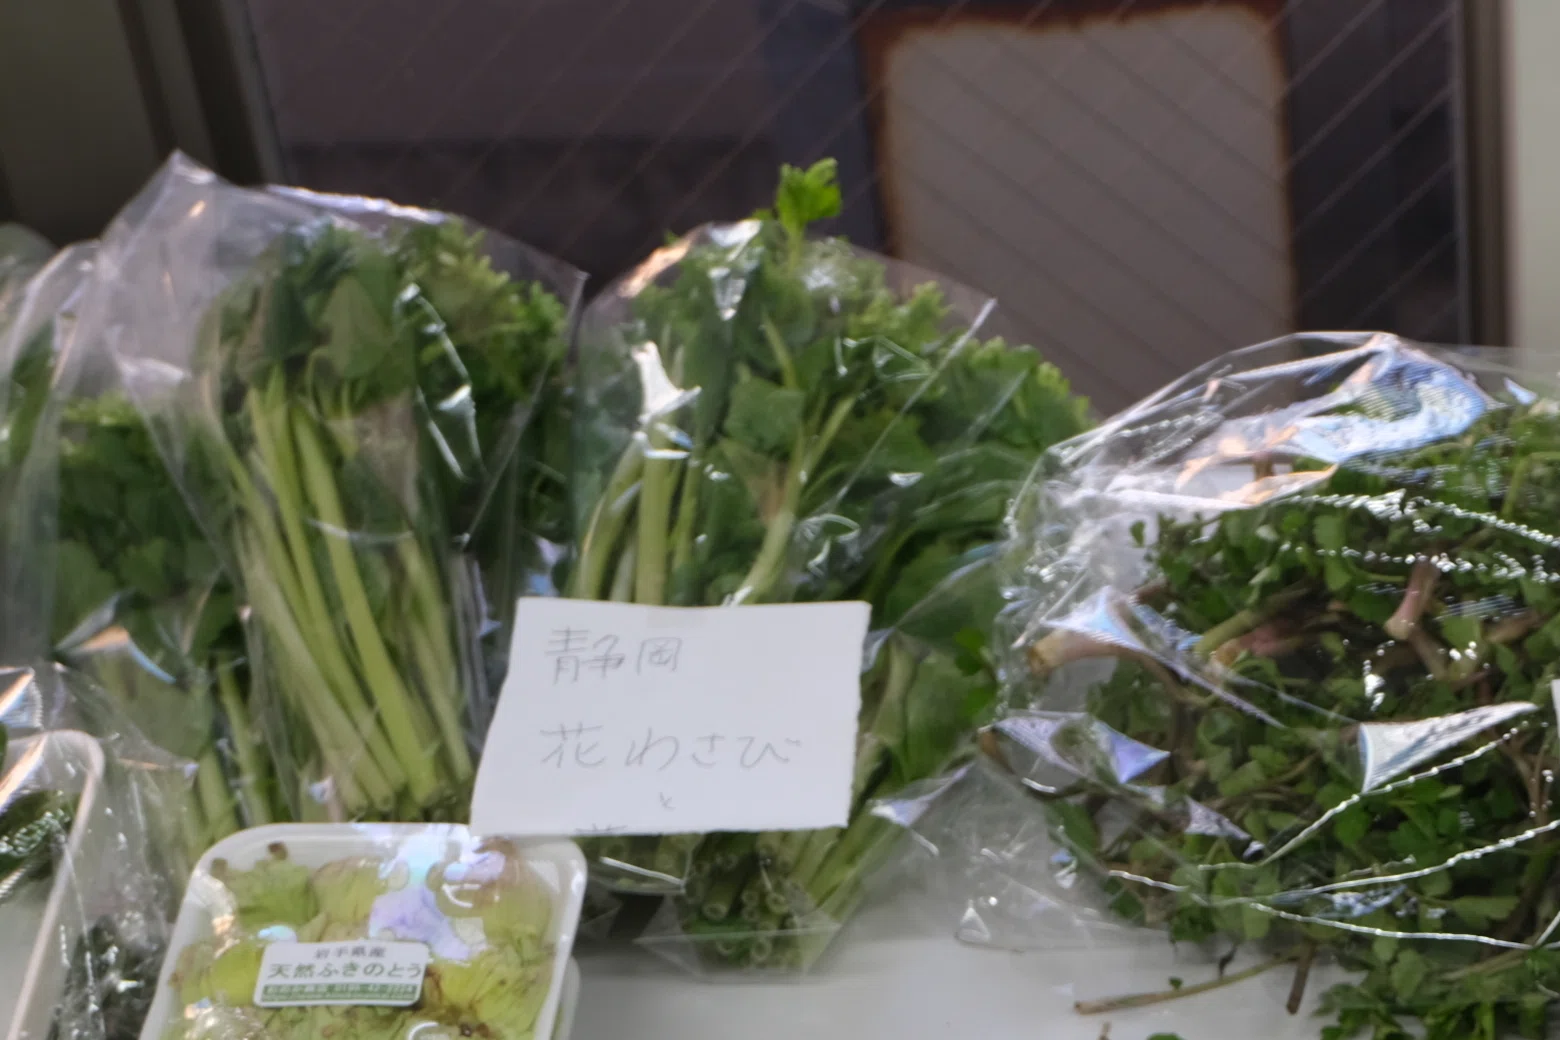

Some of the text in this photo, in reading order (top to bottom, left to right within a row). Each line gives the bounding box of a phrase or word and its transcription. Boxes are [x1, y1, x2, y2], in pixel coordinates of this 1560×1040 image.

[546, 627, 683, 683] 静岡
[540, 722, 802, 771] 花わさび
[314, 945, 387, 959] 岩手県産
[267, 962, 422, 979] 天然ふきのとう
